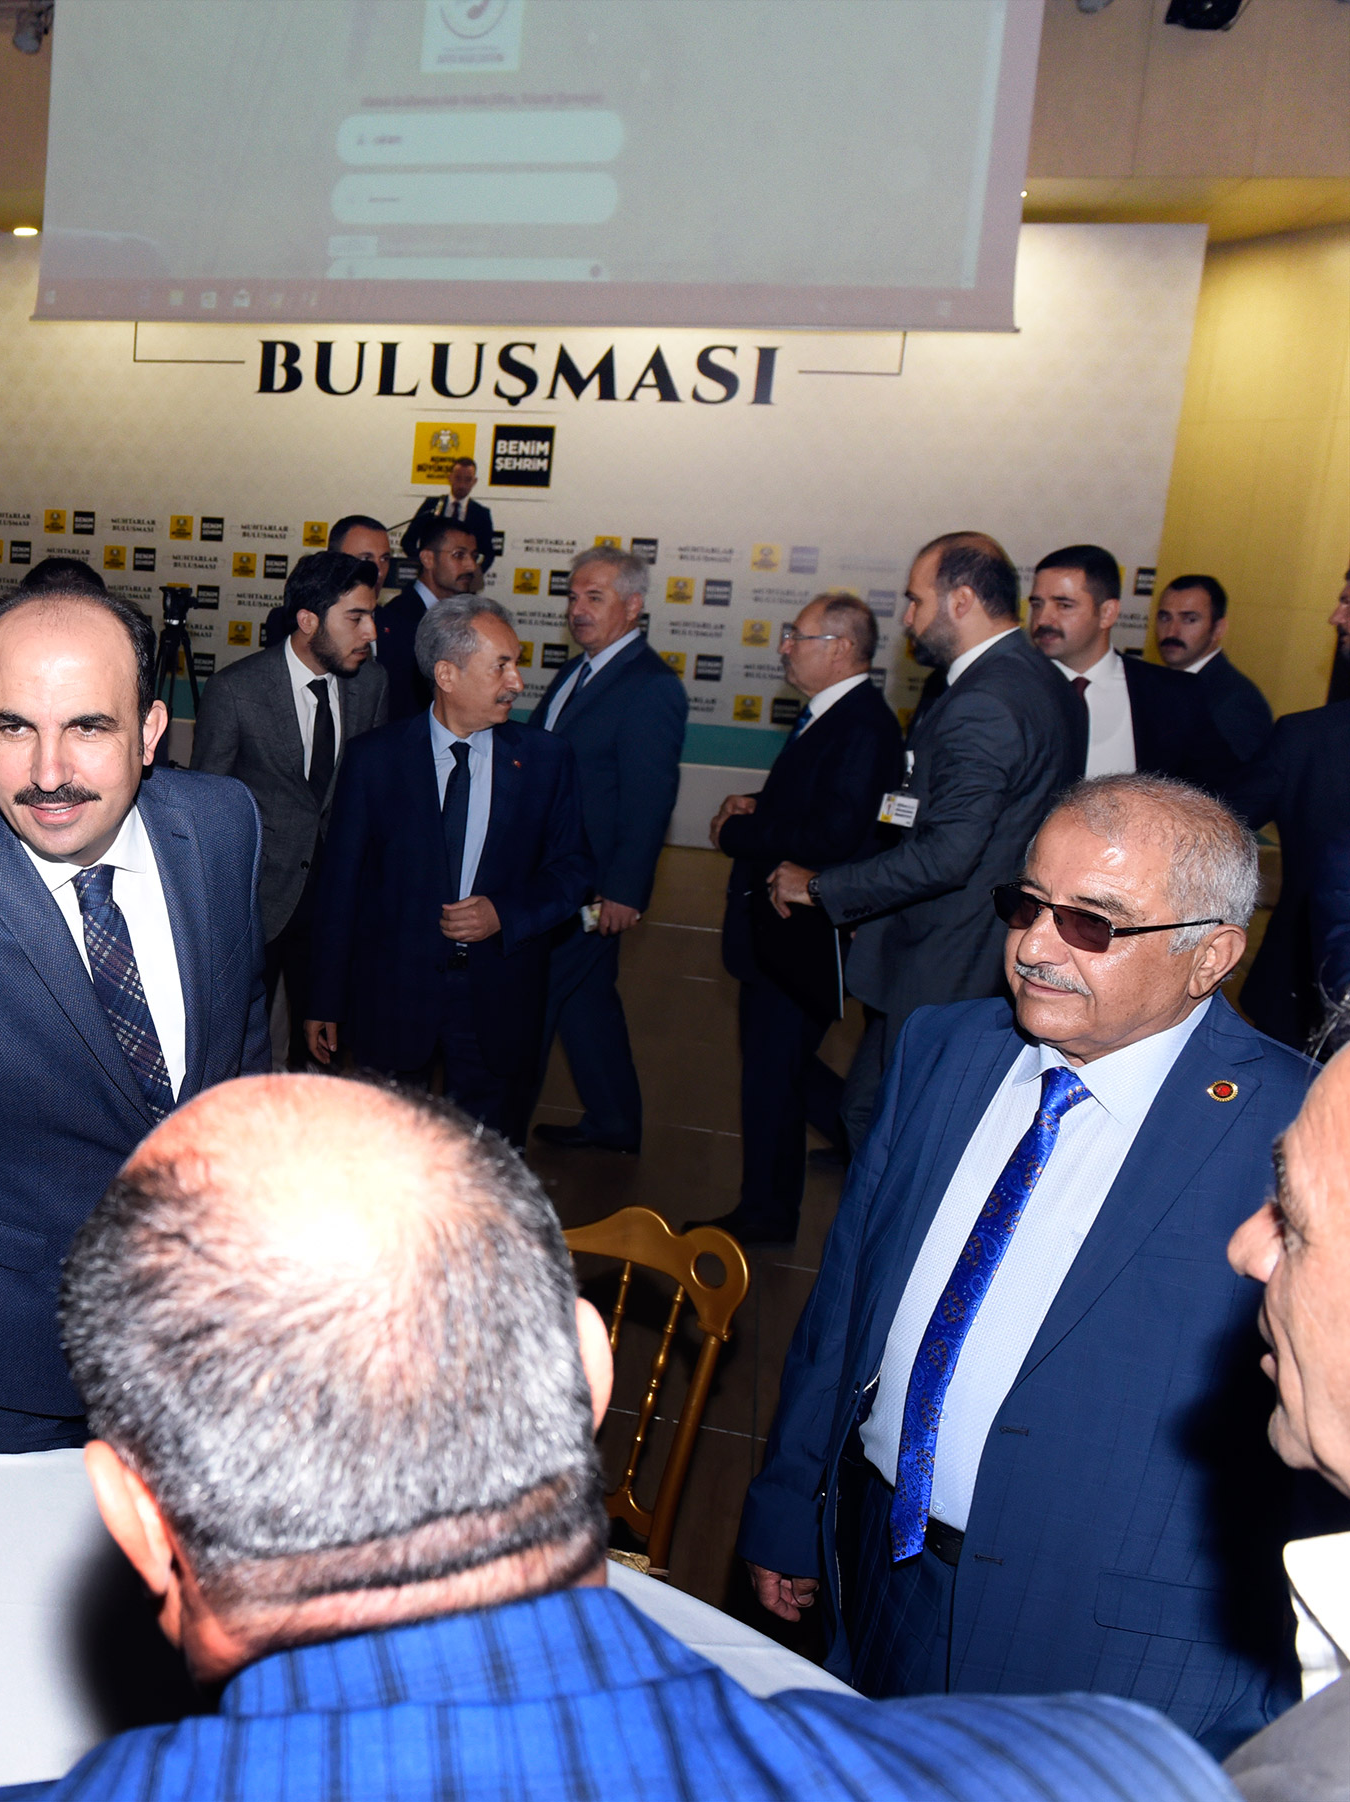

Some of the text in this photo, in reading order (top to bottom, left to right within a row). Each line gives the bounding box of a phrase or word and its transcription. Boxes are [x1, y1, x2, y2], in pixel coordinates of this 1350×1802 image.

[254, 340, 782, 407] BULUŞMASI
[496, 439, 550, 456] BENİM
[495, 456, 548, 472] ŞEHRİM
